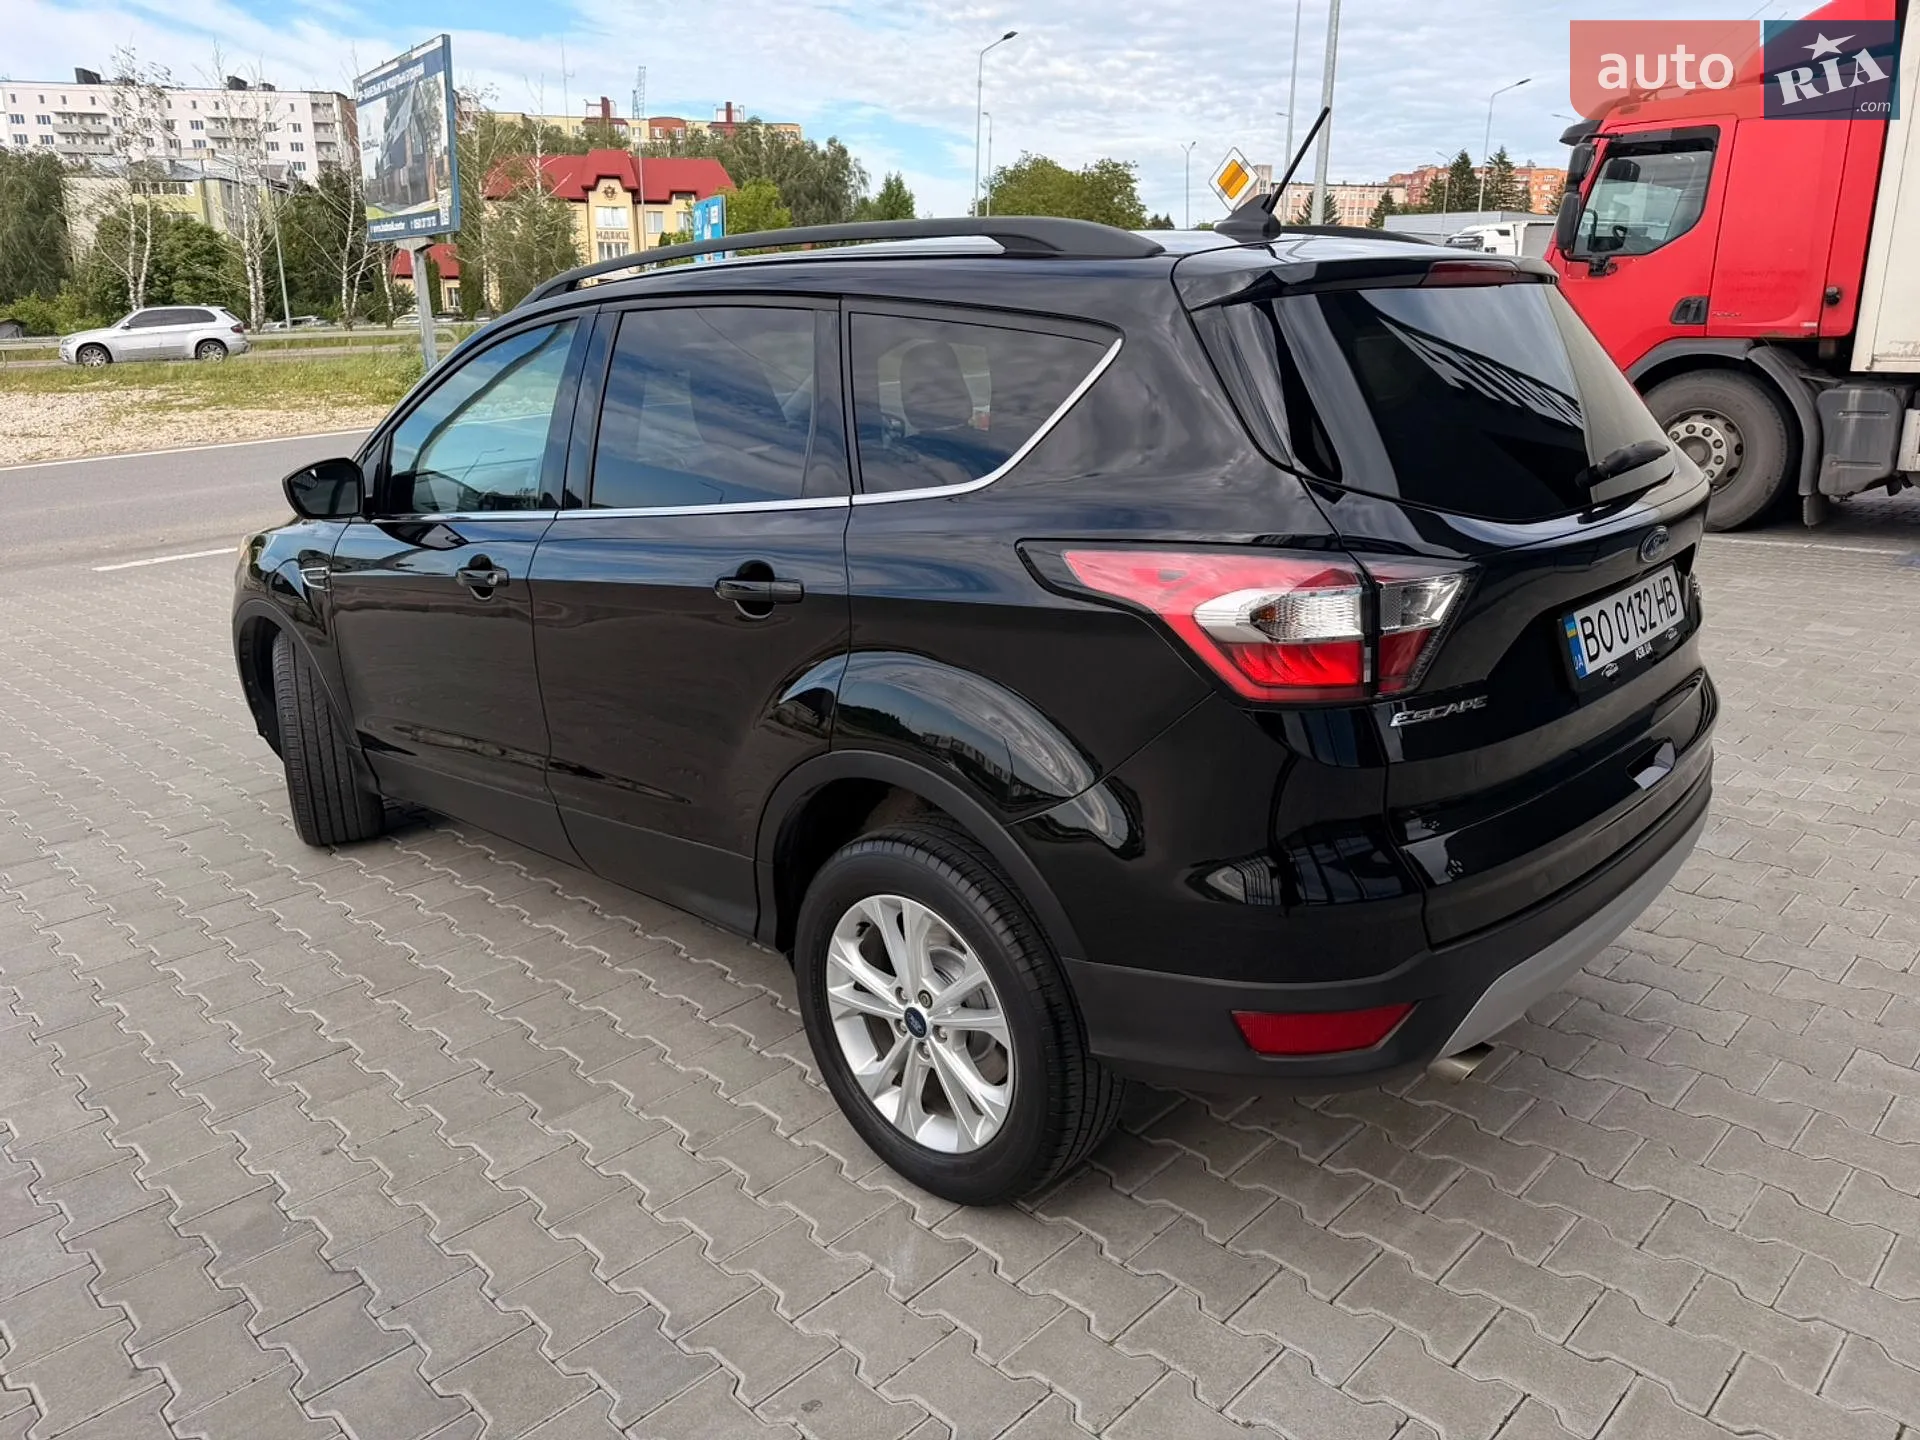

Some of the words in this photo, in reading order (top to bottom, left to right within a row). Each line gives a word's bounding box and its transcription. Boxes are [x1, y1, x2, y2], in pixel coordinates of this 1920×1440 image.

[1580, 609, 1614, 663] BO
[1614, 587, 1658, 644] 0132
[1652, 575, 1678, 625] HB
